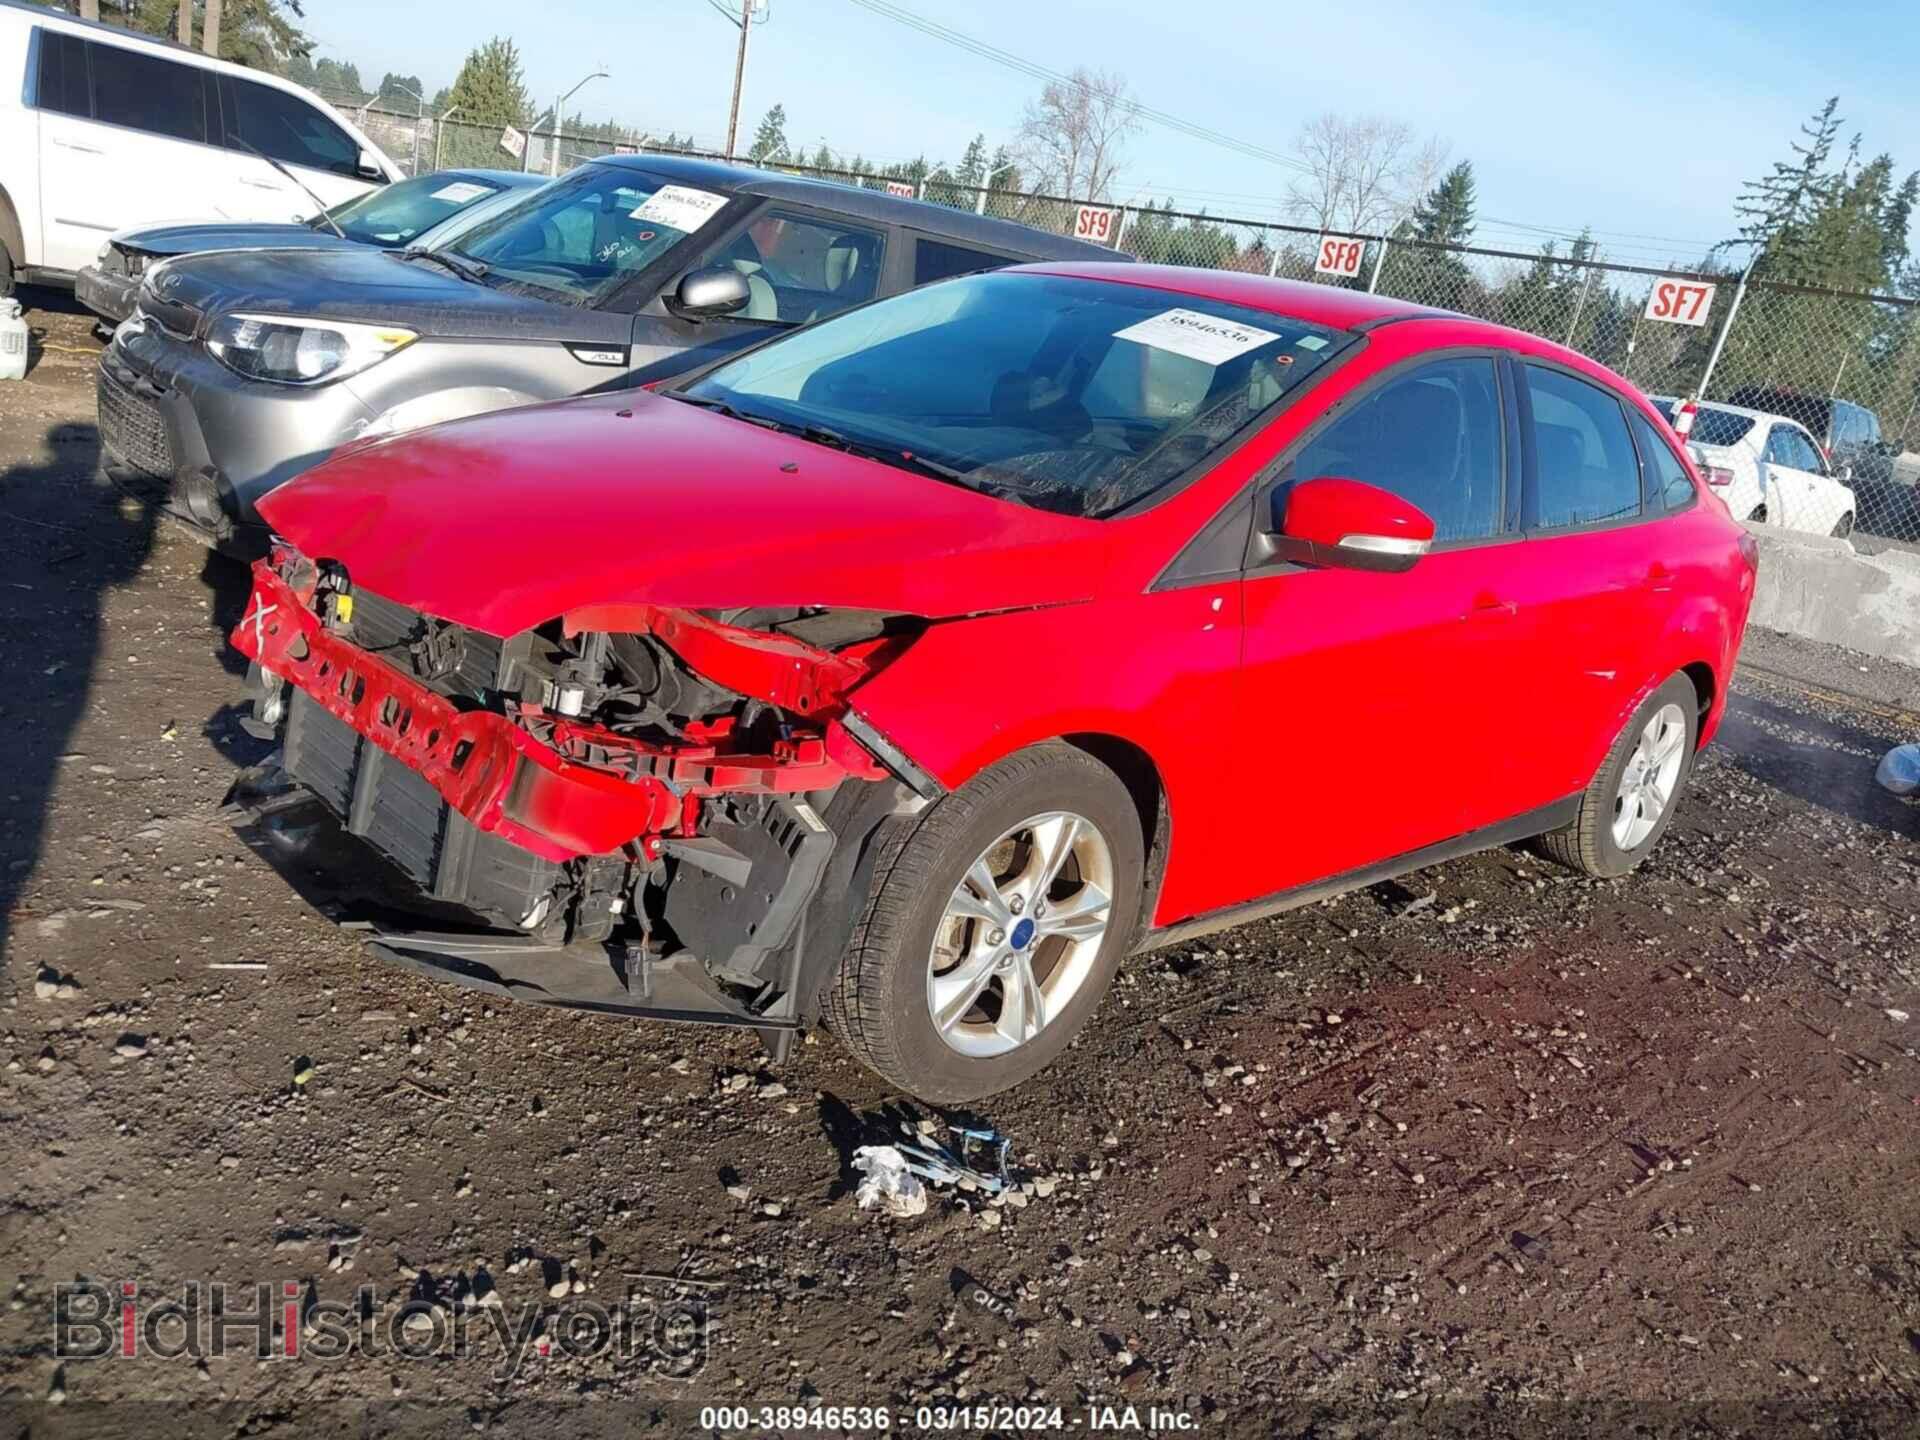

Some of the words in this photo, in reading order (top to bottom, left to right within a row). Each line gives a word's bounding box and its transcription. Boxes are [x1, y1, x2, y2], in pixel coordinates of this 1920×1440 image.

[1078, 208, 1109, 237] SF9
[1320, 240, 1360, 273] SF8
[1653, 282, 1707, 320] SF7
